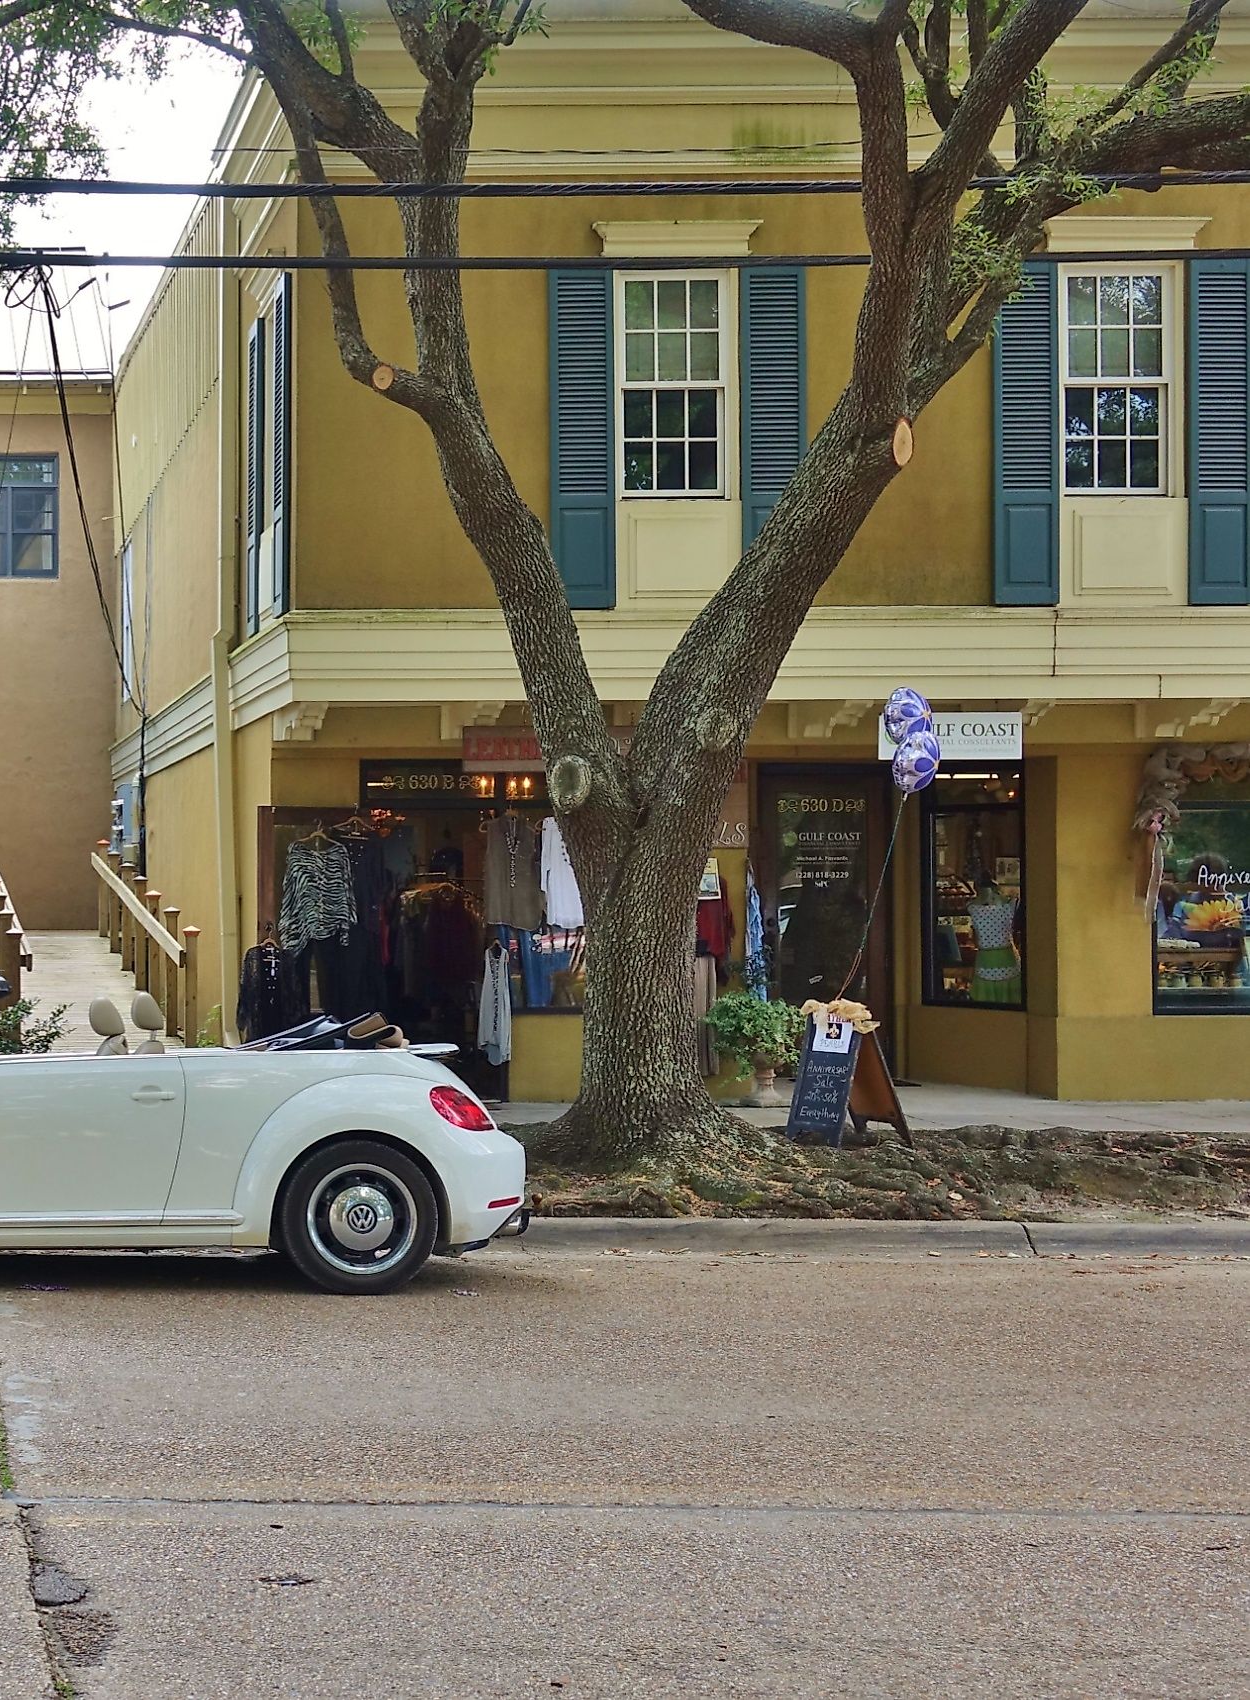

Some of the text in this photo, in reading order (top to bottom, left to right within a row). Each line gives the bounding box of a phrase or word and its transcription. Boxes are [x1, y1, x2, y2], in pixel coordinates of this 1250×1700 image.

[961, 723, 1019, 737] COAST
[409, 774, 438, 790] 630
[800, 798, 845, 812] 630 D
[798, 832, 862, 841] GULF COAST
[795, 871, 850, 880] (228) 818-3229
[814, 1075, 835, 1088] Sale
[347, 1203, 378, 1234] VW
